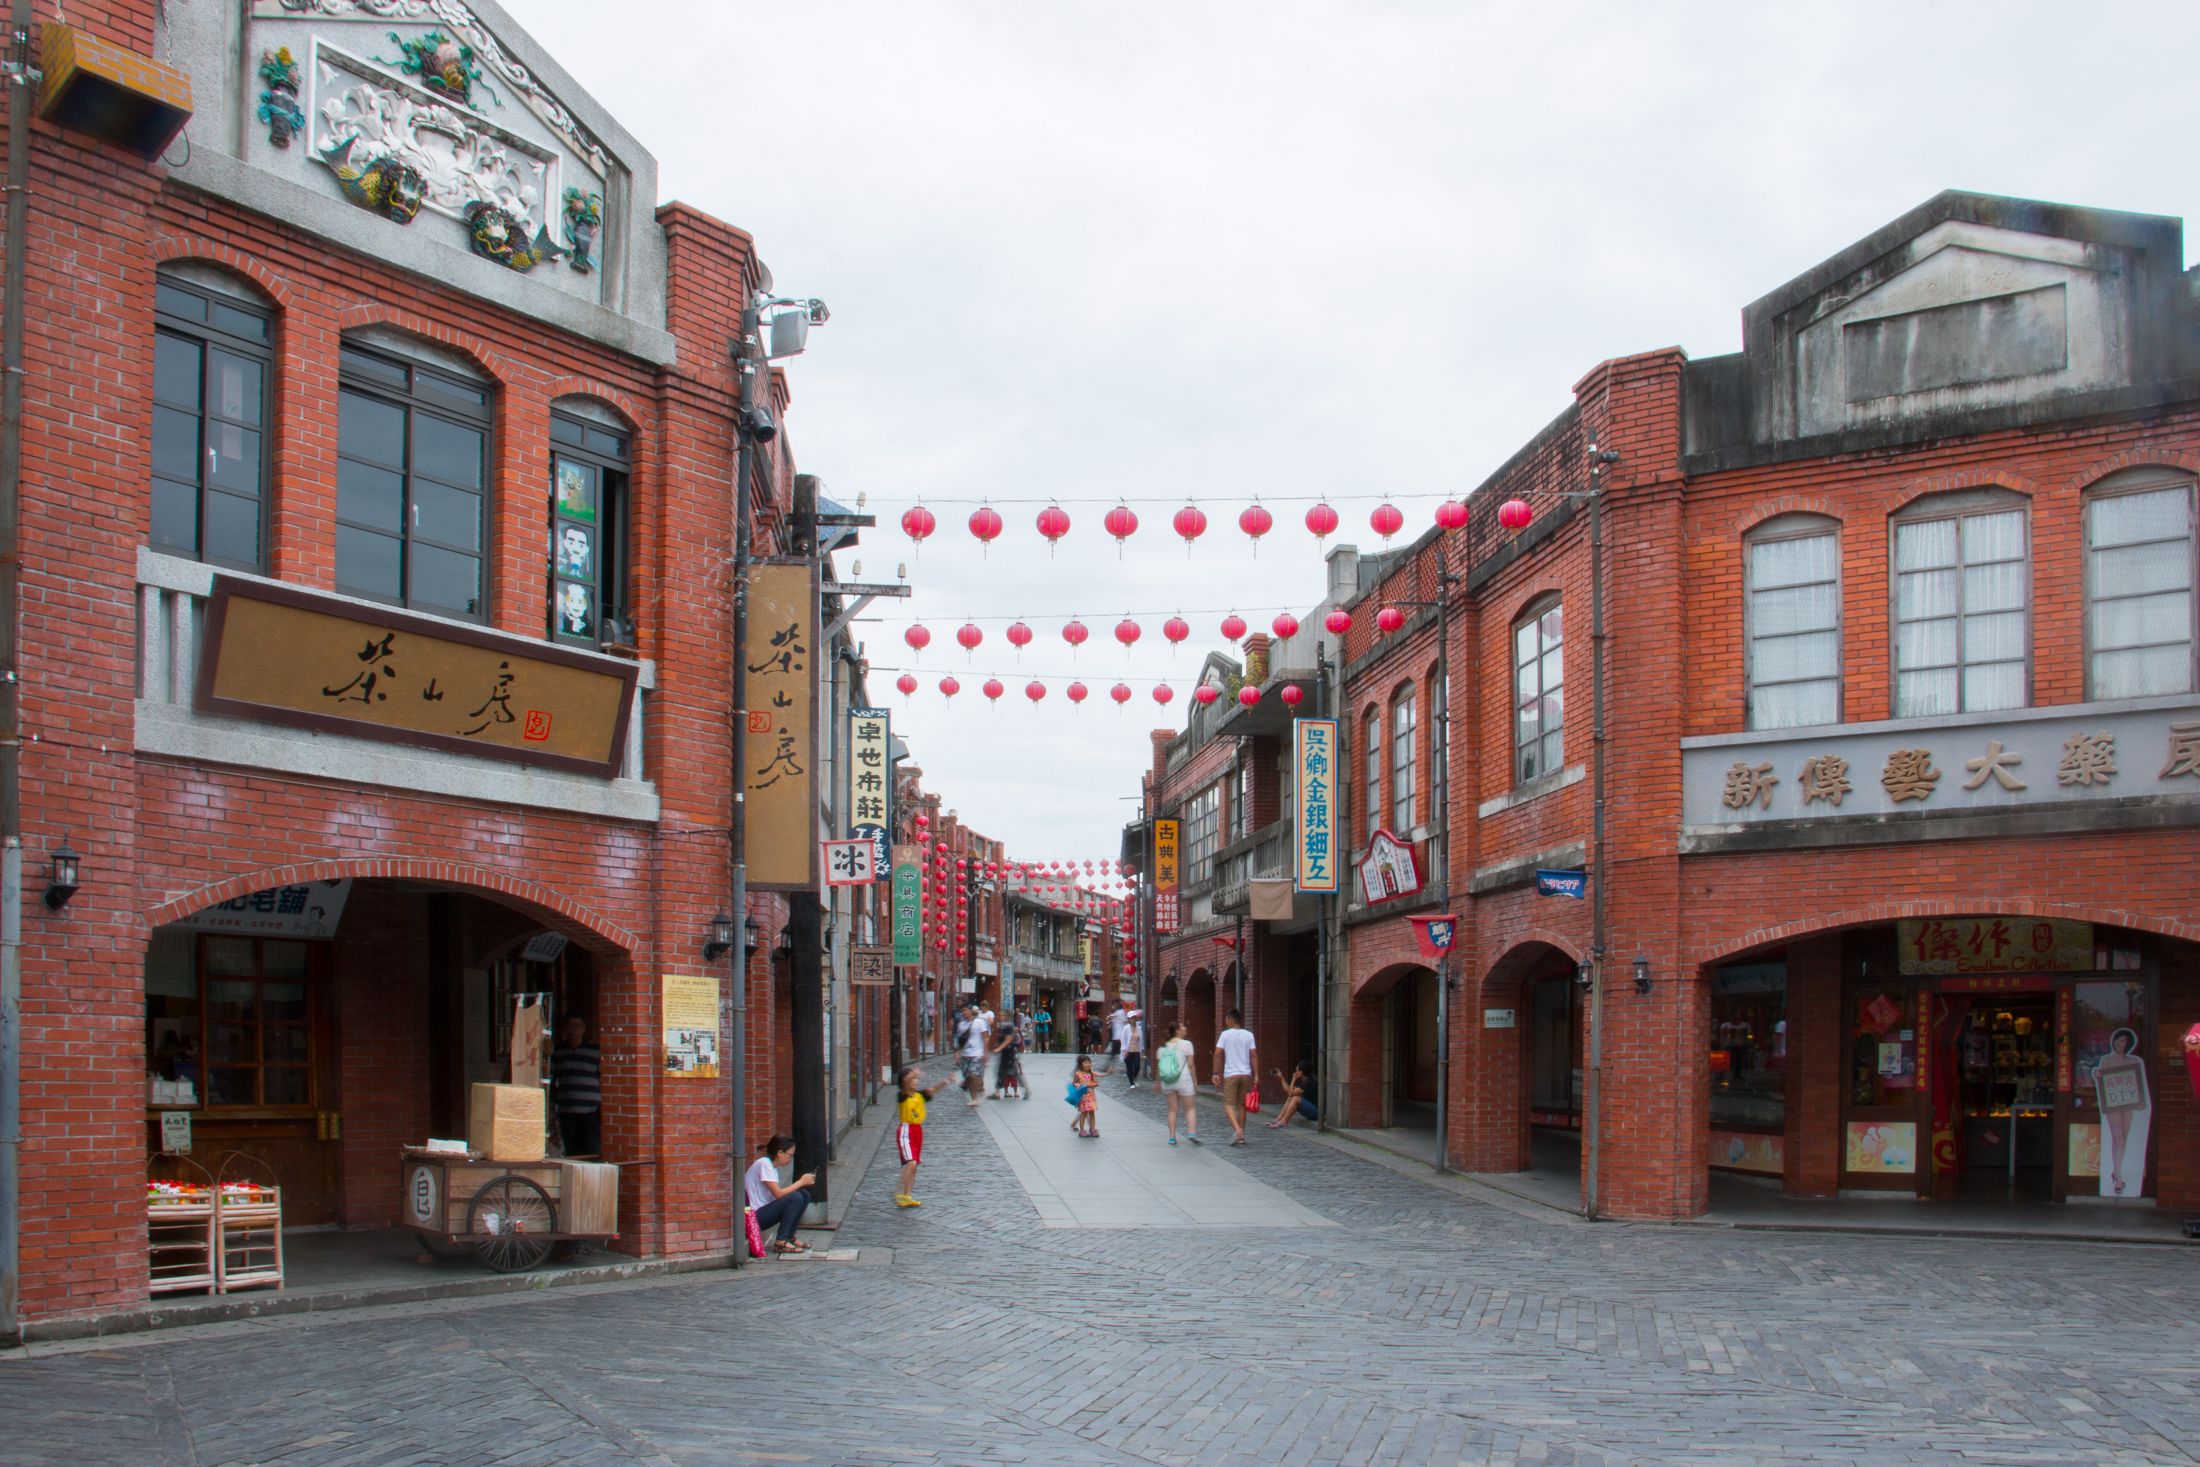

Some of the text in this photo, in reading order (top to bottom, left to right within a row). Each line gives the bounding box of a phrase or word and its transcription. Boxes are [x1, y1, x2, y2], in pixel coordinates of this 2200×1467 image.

[322, 633, 516, 735] 茶山房
[748, 623, 806, 789] 茶山房
[856, 721, 884, 819] 卓也布莊
[1722, 720, 2200, 811] 新傳藝大藥房
[1158, 823, 1175, 883] 古典美
[863, 956, 882, 977] 染
[2109, 1089, 2137, 1103] DIY
